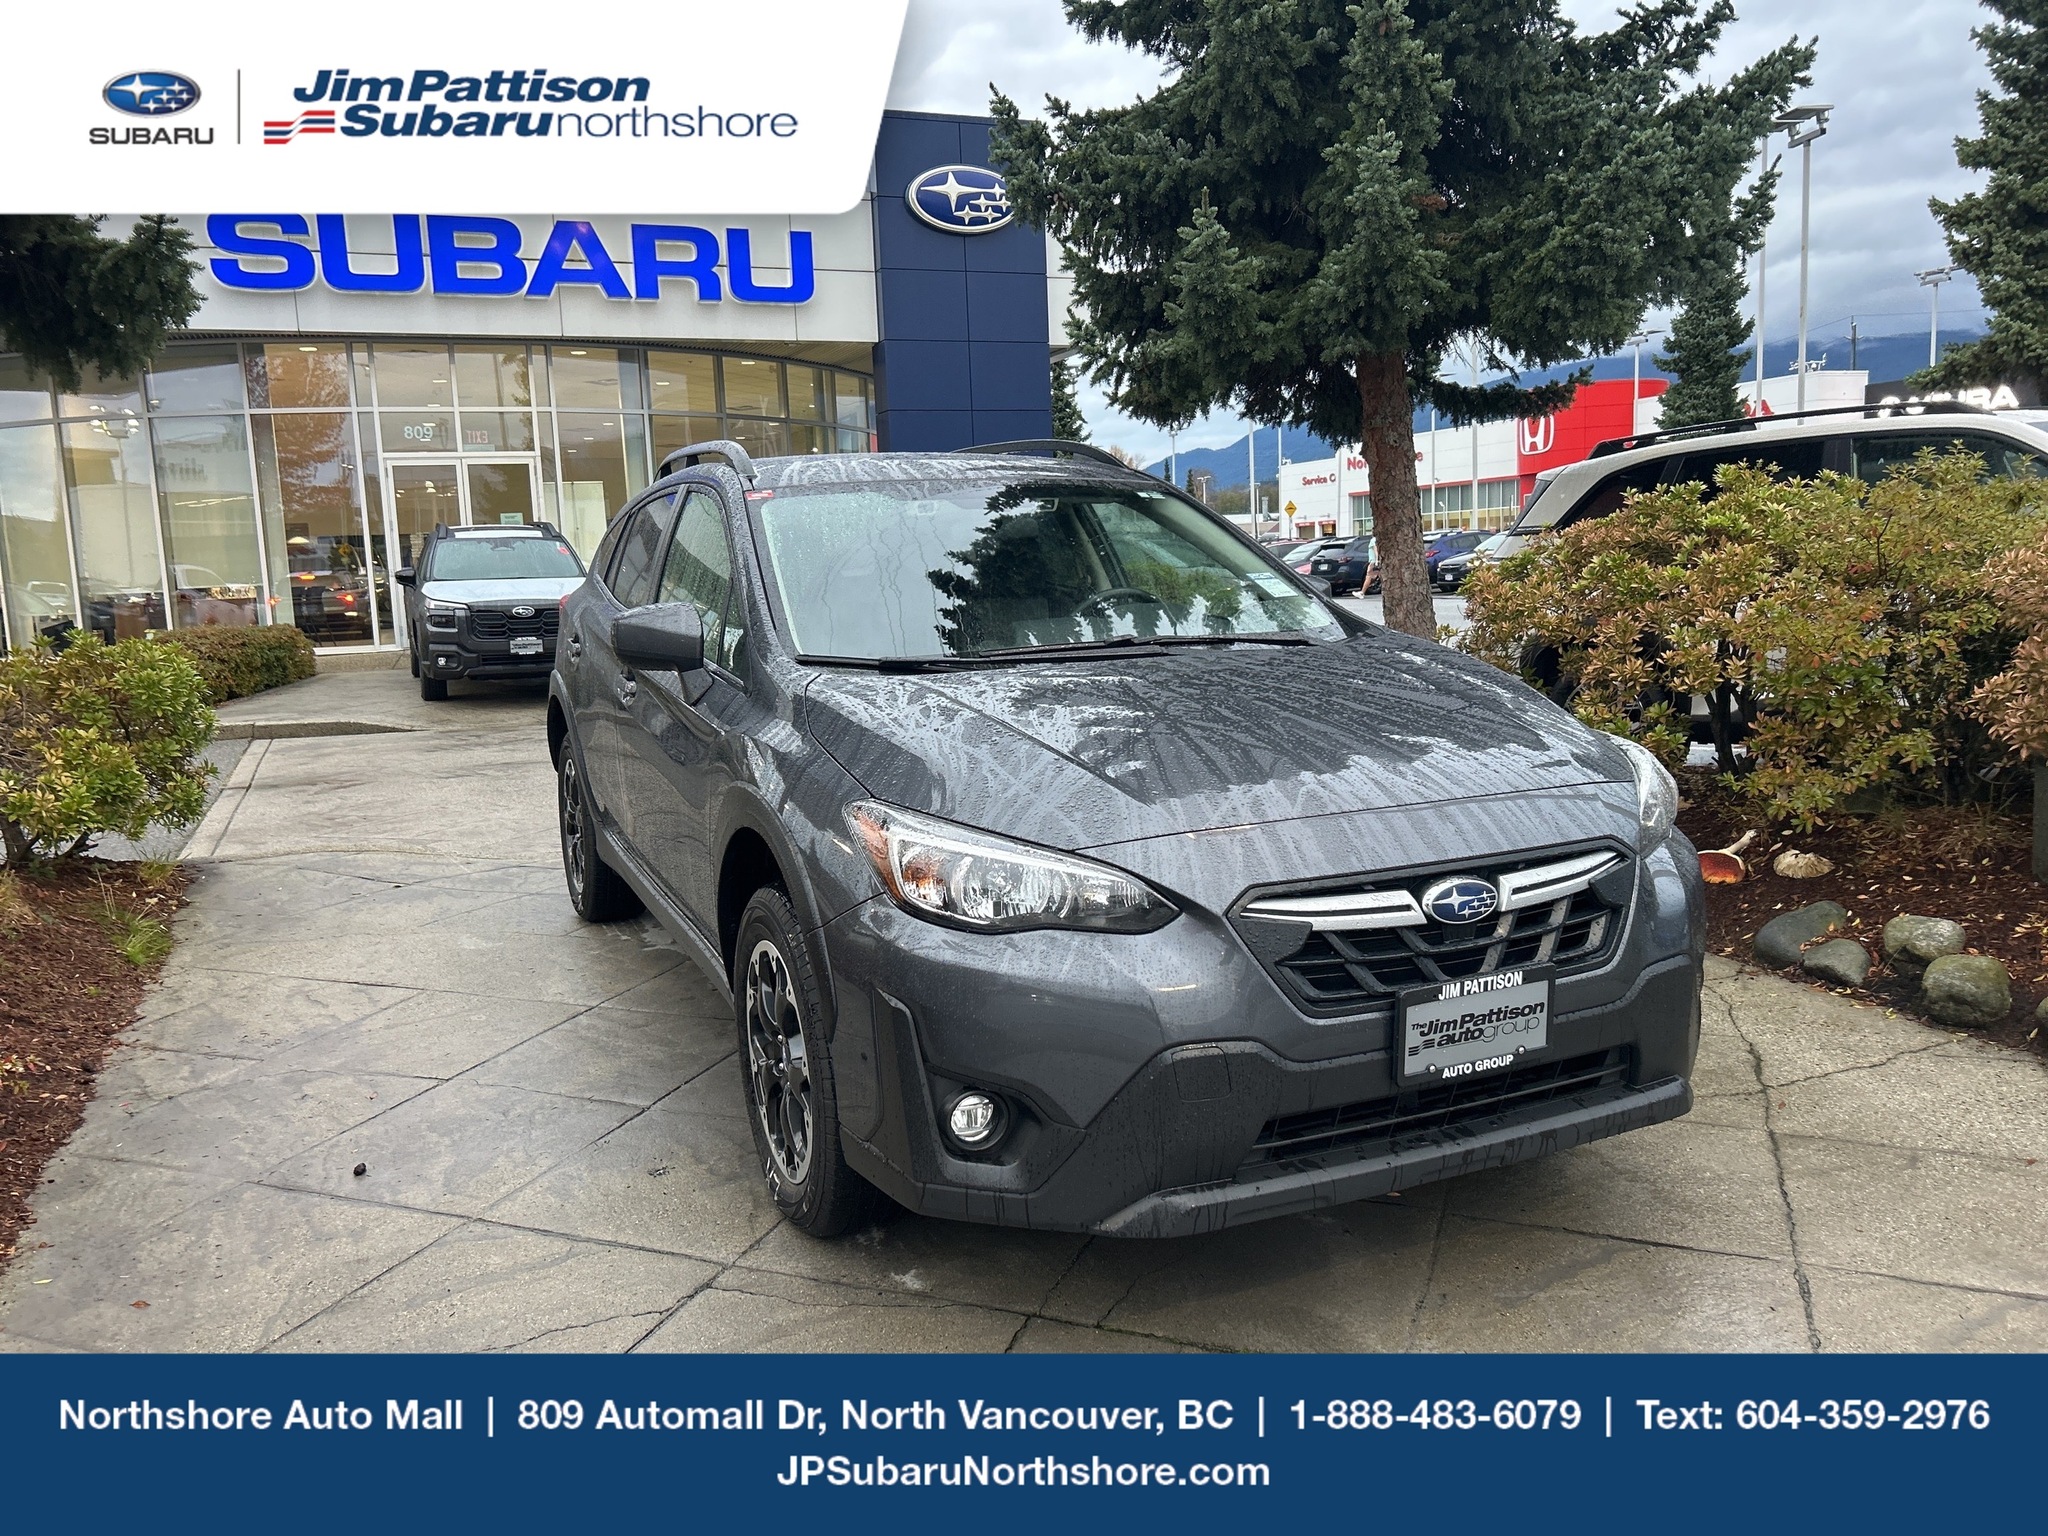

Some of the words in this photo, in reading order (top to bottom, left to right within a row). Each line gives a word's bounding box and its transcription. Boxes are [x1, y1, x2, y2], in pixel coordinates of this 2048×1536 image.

[207, 214, 815, 305] SUBARU
[404, 426, 433, 440] 809
[1301, 475, 1328, 487] Service
[1438, 982, 1461, 1001] JIM
[1463, 971, 1524, 996] PATTISON
[1442, 1061, 1473, 1079] AUTO
[1474, 1054, 1514, 1072] GROUP
